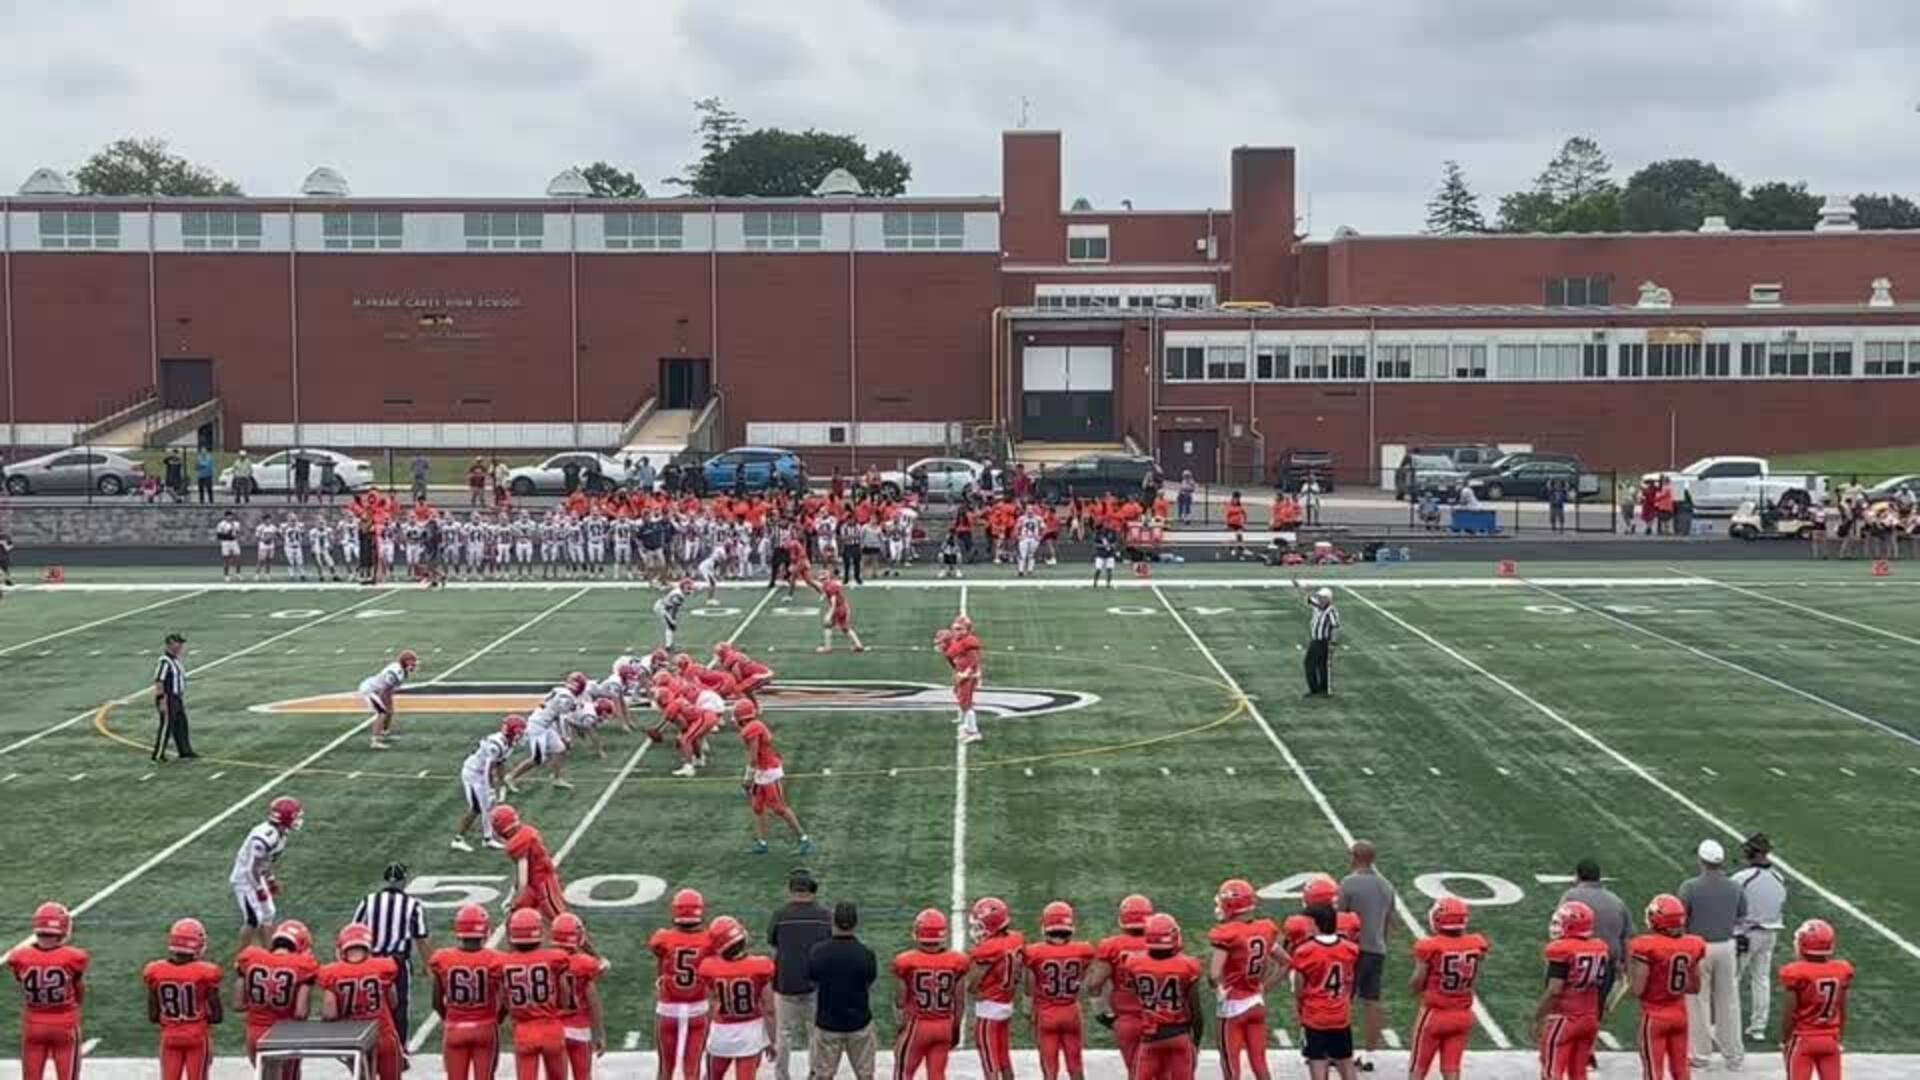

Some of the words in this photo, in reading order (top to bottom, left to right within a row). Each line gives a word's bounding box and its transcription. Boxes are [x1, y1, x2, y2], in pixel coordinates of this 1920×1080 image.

[404, 874, 667, 907] 50
[674, 947, 699, 988] 5
[1248, 936, 1266, 978] 2
[1440, 952, 1480, 992] 57
[1669, 953, 1689, 995] 6
[23, 967, 68, 1005] 42
[247, 965, 295, 1008] 63
[337, 977, 383, 1016] 73
[449, 966, 488, 1006] 61
[503, 963, 550, 1007] 58
[715, 978, 754, 1016] 18
[914, 969, 955, 1011] 52
[1042, 959, 1082, 998] 32
[1135, 974, 1182, 1011] 24
[1323, 960, 1344, 1000] 4
[160, 982, 200, 1020] 81
[1816, 977, 1838, 1023] 7
